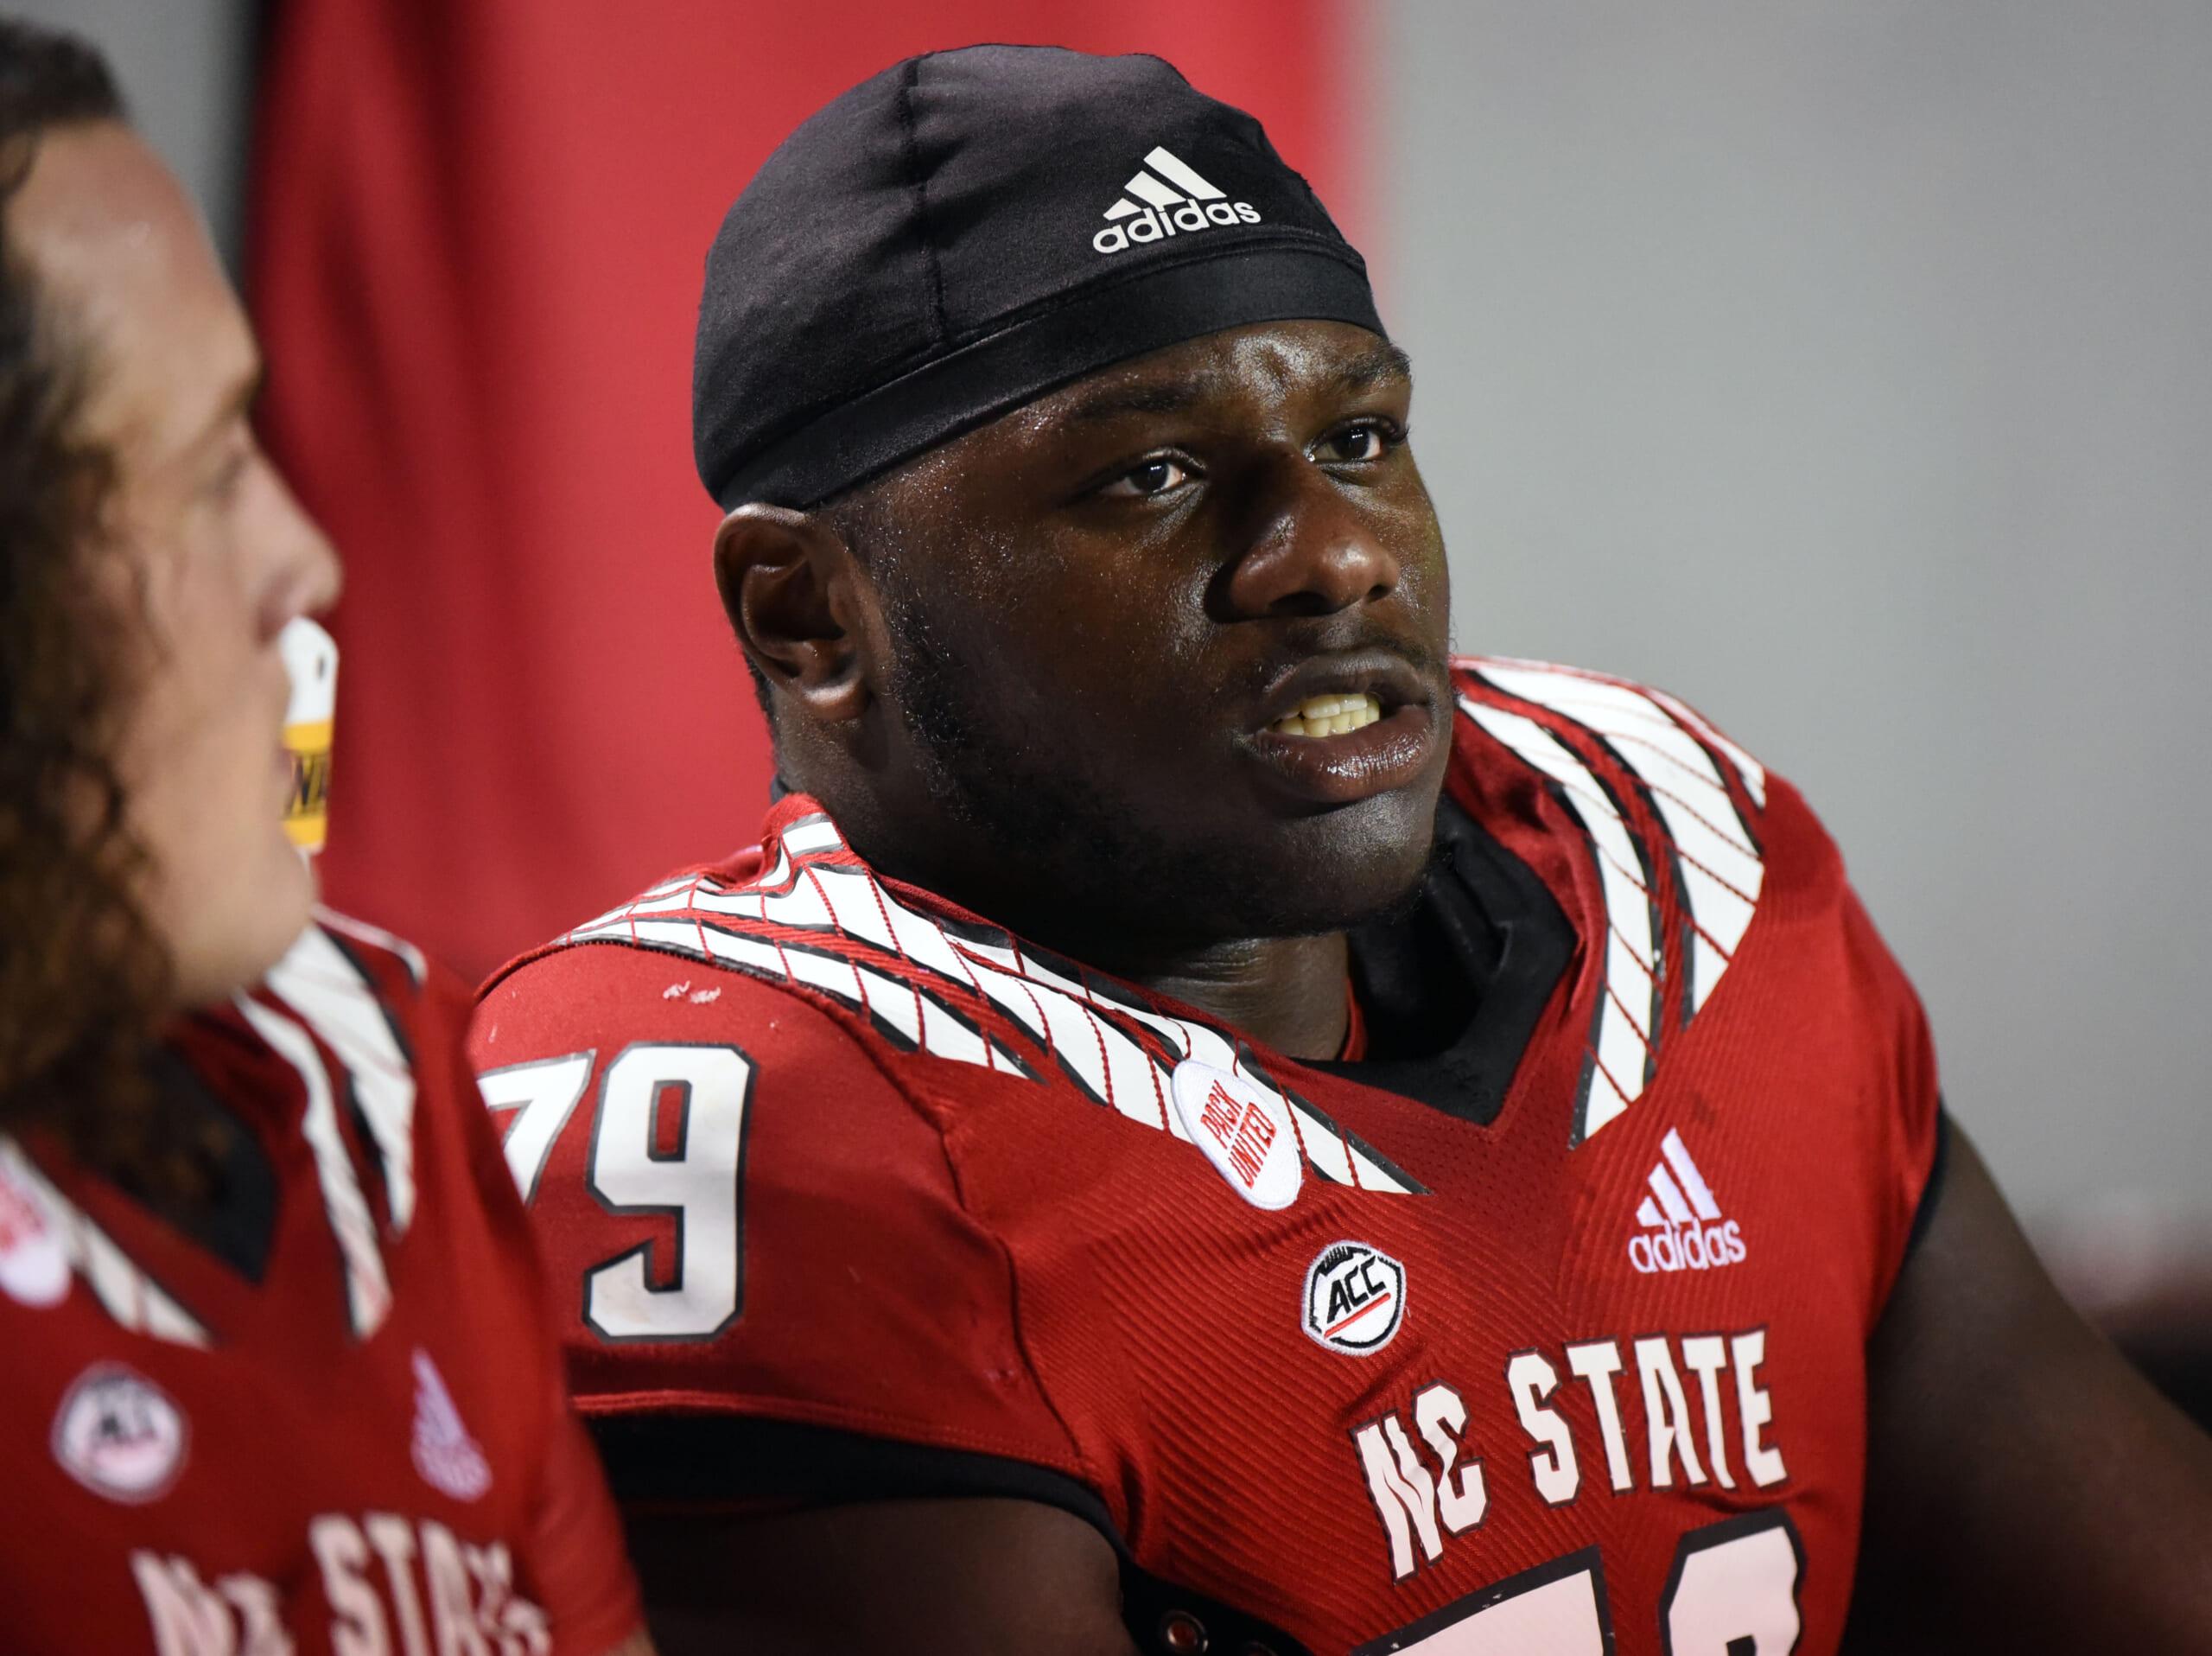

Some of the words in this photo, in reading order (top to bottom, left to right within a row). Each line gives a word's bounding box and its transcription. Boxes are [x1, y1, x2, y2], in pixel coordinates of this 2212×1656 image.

[1092, 198, 1262, 254] adidas
[1200, 1079, 1243, 1150] PACK
[1227, 1101, 1277, 1190] UNITED
[476, 1041, 759, 1345] 79
[1628, 1216, 1747, 1274] adidas
[1326, 1254, 1387, 1324] ACC
[1350, 1379, 1491, 1585] NC
[1504, 1324, 1789, 1510] STATE
